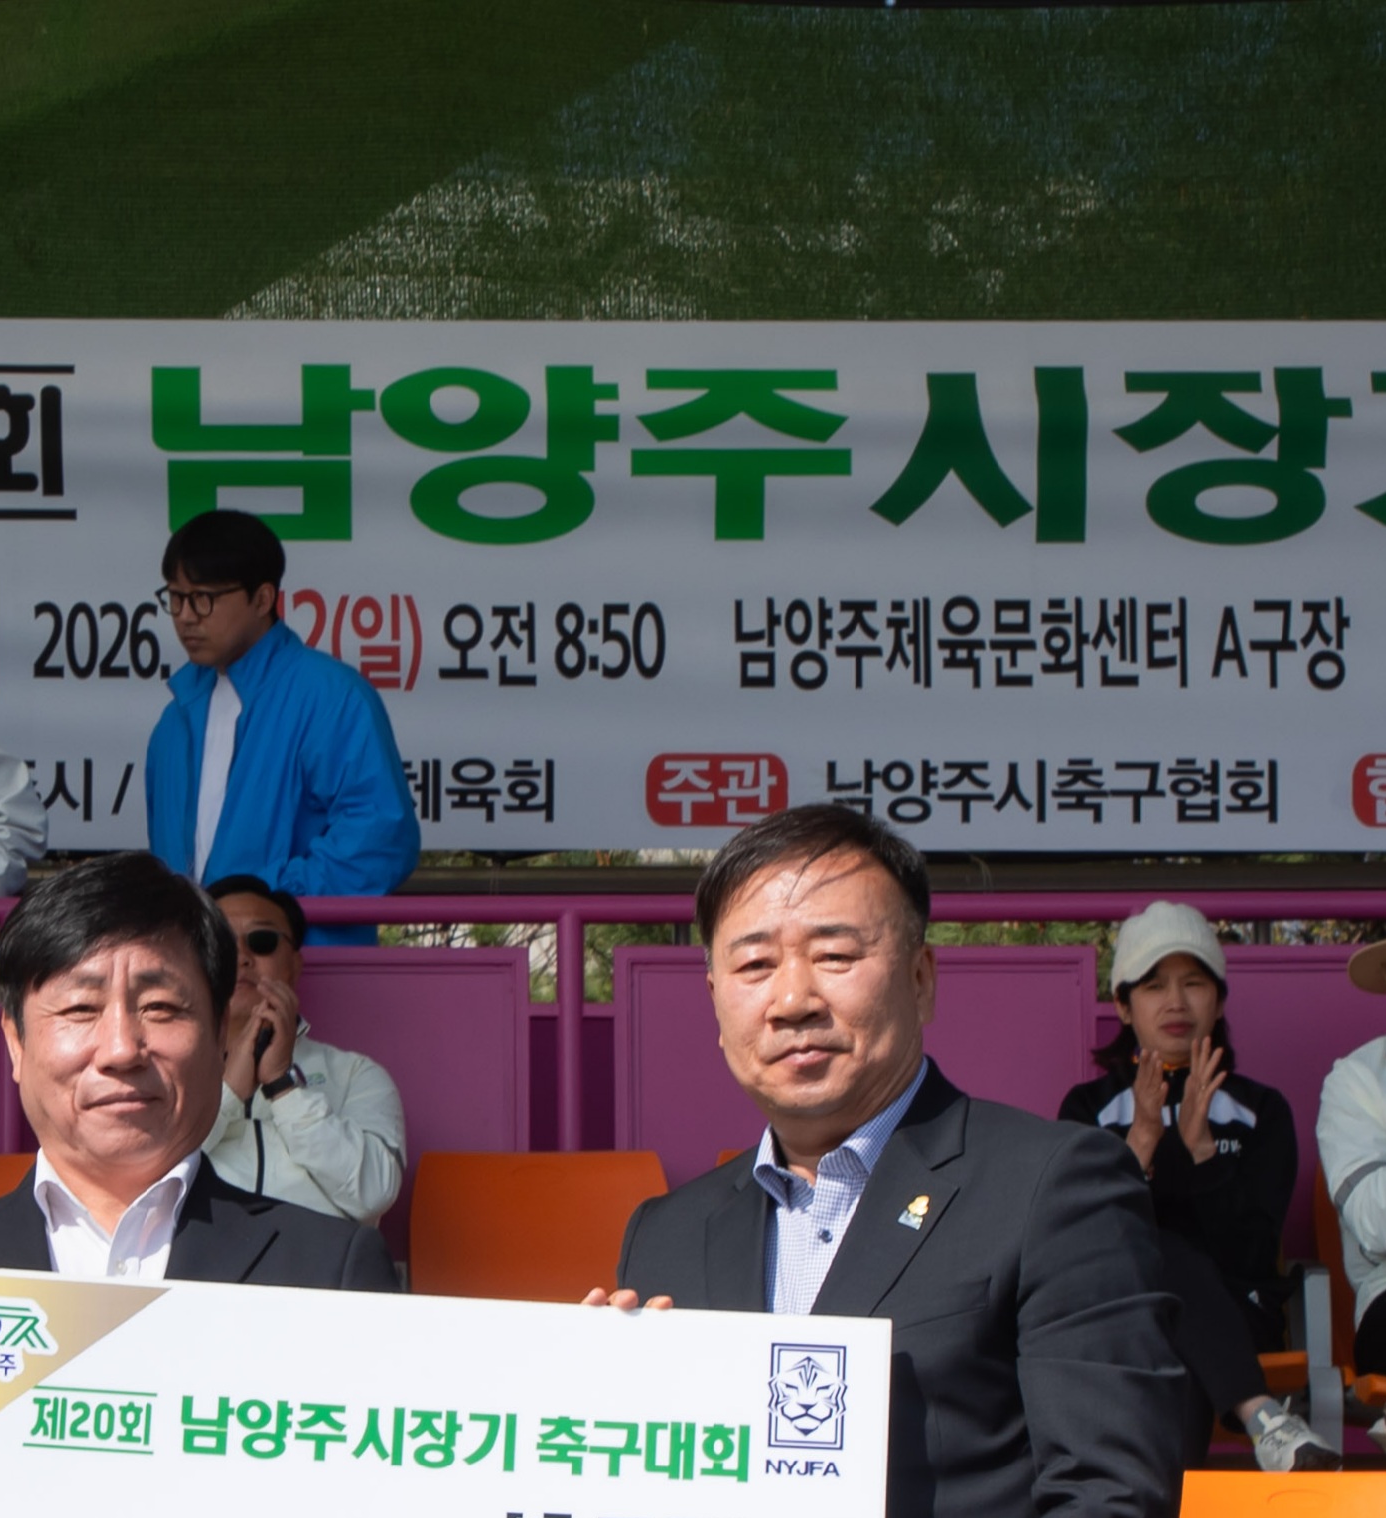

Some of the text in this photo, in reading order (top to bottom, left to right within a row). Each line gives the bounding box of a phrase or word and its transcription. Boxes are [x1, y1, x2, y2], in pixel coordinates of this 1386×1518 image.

[33, 589, 1350, 691] 2026. 2(일) 오전 8:50 남양주체육문화센터 A구장
[658, 758, 778, 822] 주관
[824, 757, 1279, 825] 남양주시축구협회
[30, 1394, 750, 1483] 제20회 남양주시장기 축구대회
[765, 1459, 840, 1477] NYJFA
